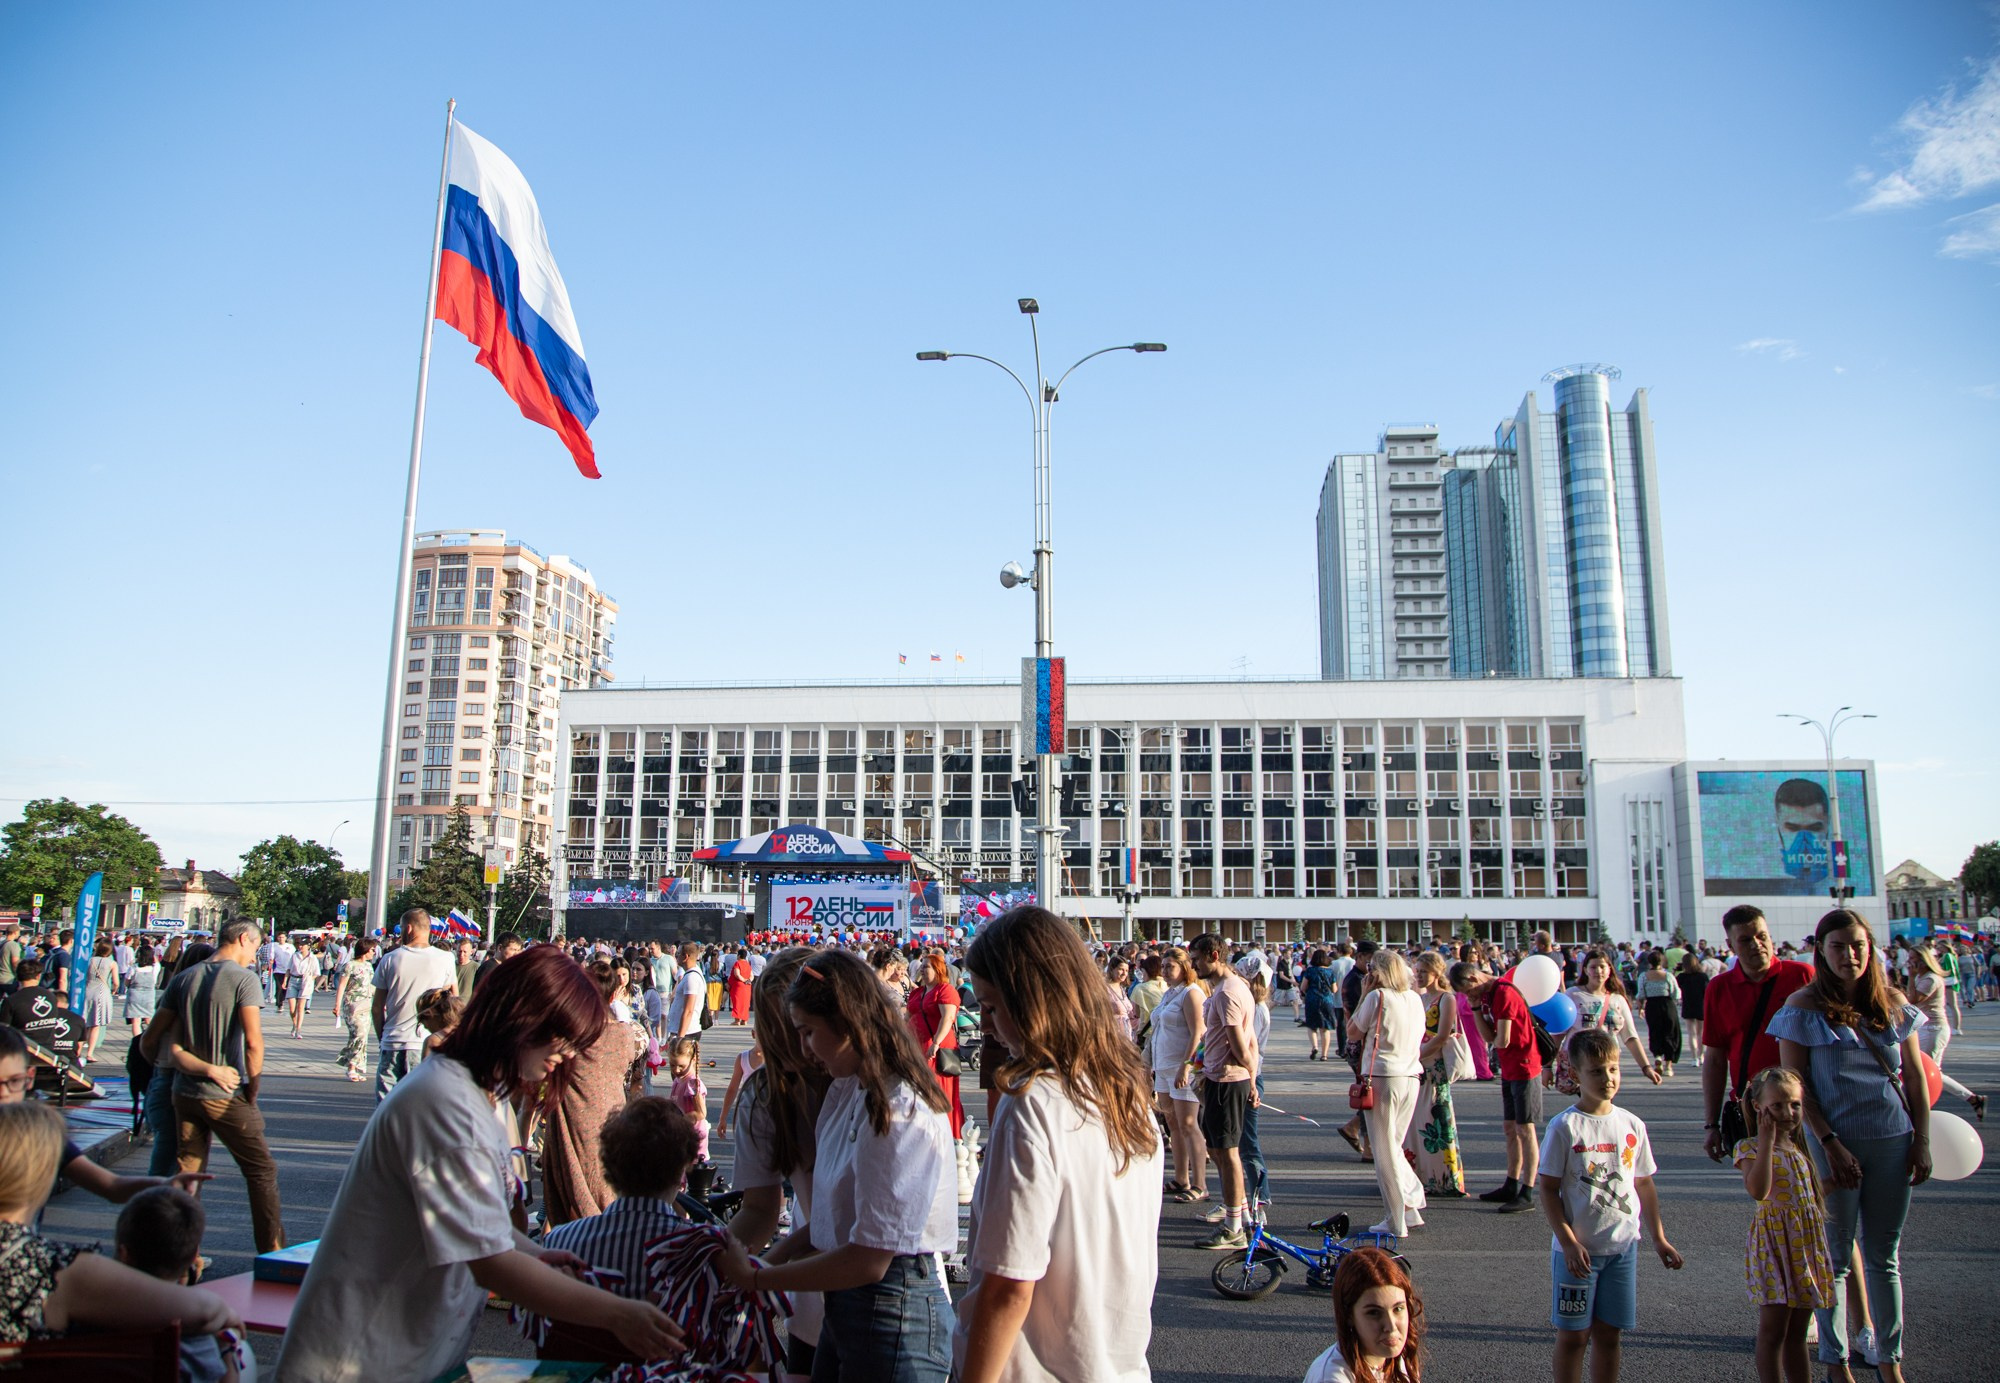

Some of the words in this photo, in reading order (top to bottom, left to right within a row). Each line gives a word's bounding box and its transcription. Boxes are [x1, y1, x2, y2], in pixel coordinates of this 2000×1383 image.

[770, 833, 787, 849] 12
[786, 833, 820, 844] ДЕНЬ
[786, 843, 836, 854] РОССИИ
[785, 896, 814, 920] 12
[813, 896, 867, 912] ДЕНЬ
[813, 911, 894, 927] РОССИИ
[78, 893, 95, 962] ZONE
[25, 1020, 39, 1028] FLY
[1560, 1287, 1587, 1300] THE
[1559, 1299, 1586, 1312] BOSS
